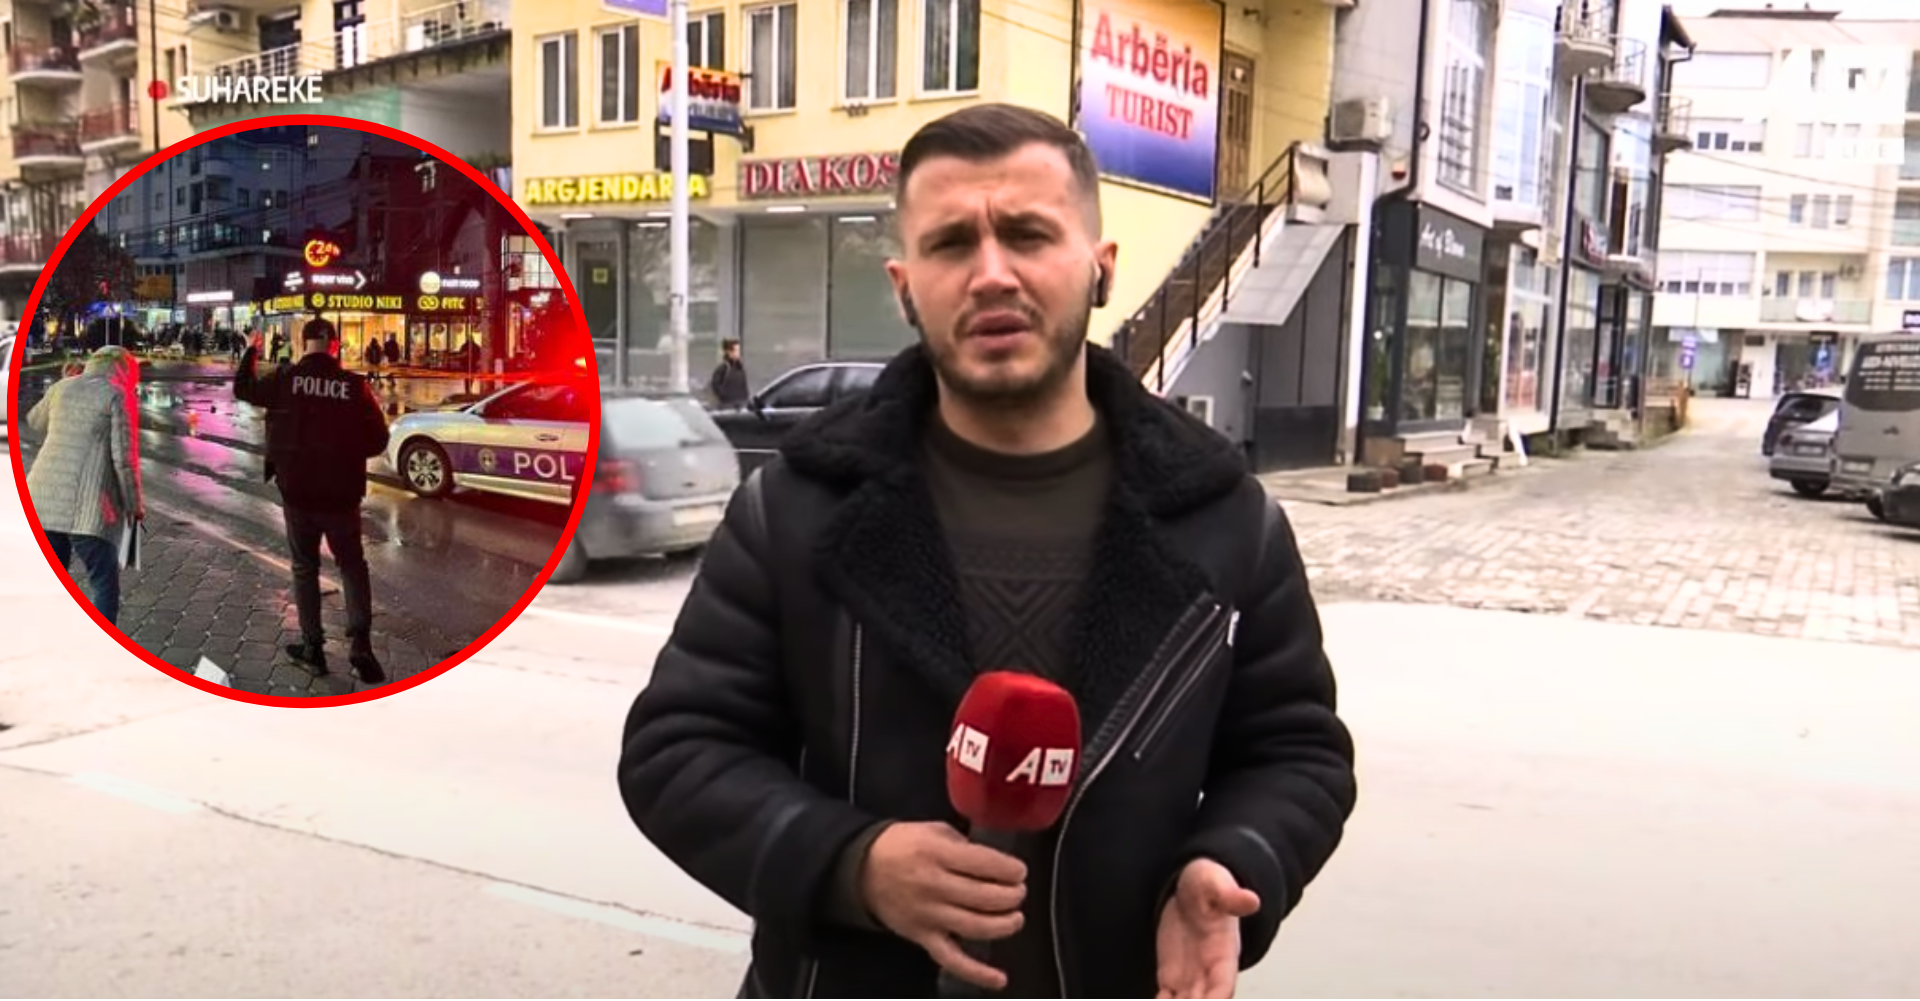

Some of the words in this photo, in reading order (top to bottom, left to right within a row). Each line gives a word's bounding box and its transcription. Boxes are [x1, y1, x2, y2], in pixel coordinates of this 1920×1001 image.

[1090, 12, 1208, 100] Arbëria
[660, 65, 741, 105] Abëria
[1105, 82, 1193, 141] TURIST
[526, 171, 708, 205] ARGJENDARA
[327, 295, 374, 309] STUDIO
[376, 296, 402, 310] NIKI
[292, 376, 350, 399] POLICE
